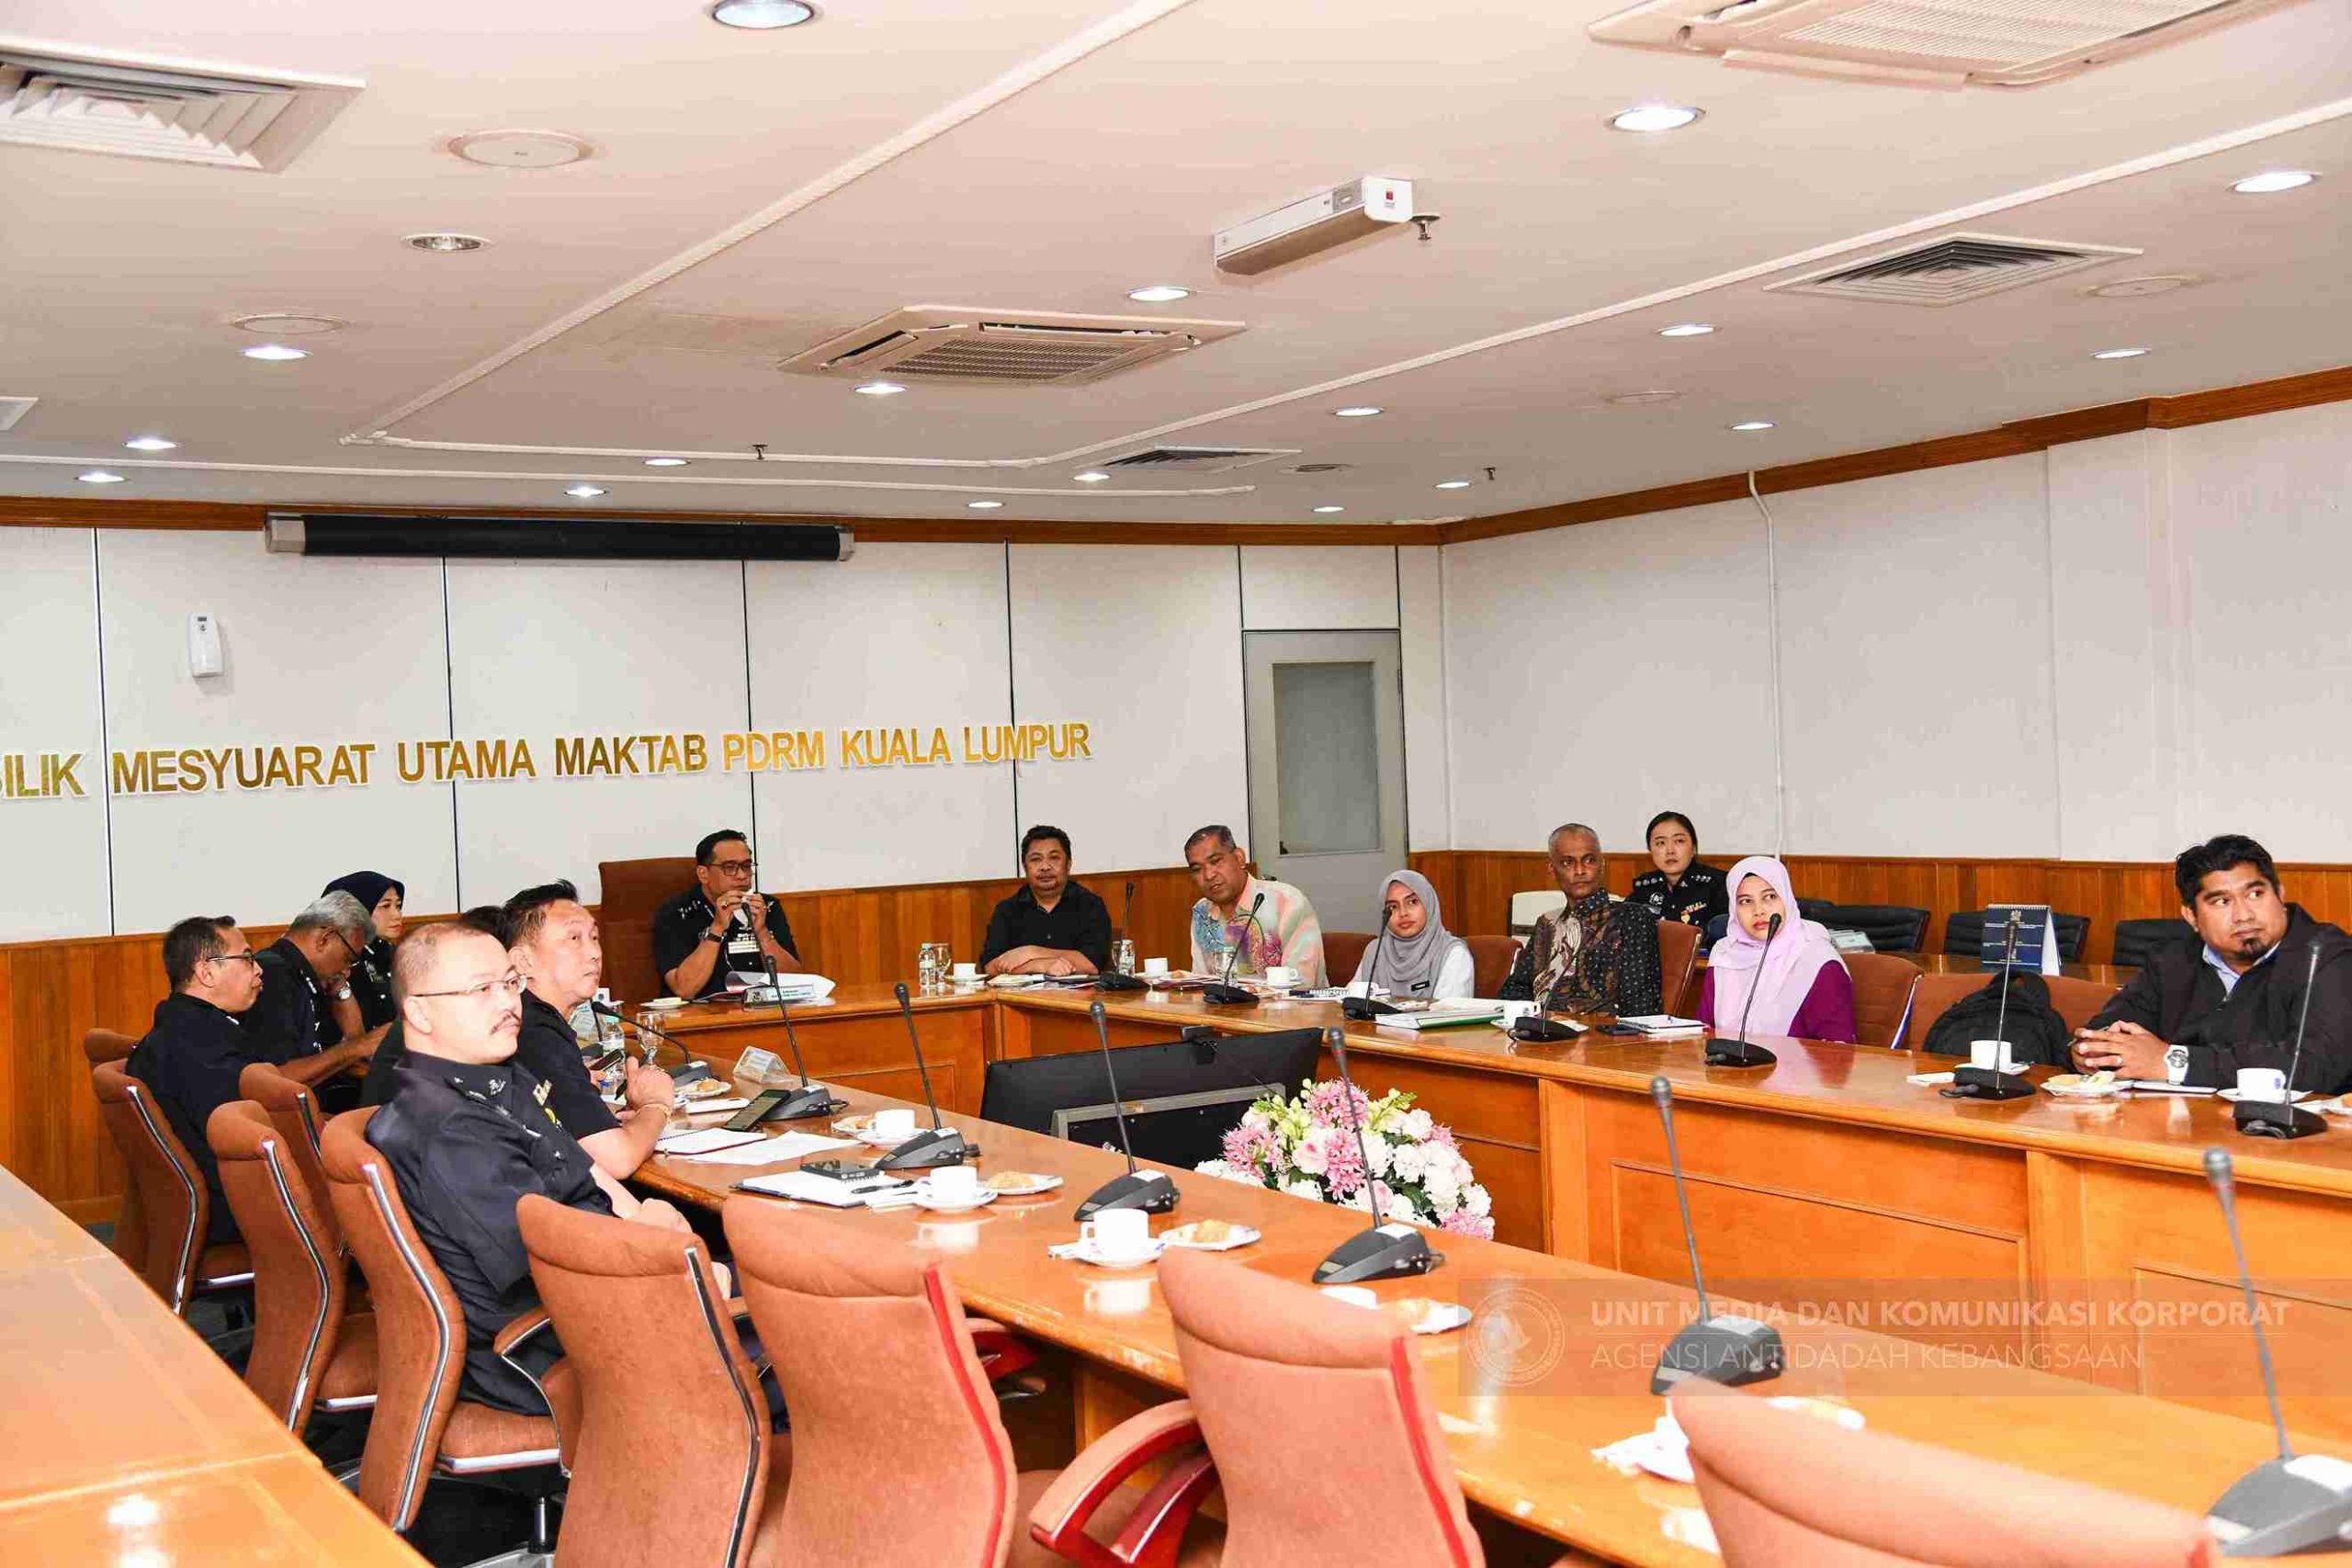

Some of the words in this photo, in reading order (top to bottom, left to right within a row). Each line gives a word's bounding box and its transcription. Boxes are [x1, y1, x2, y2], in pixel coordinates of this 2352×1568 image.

[0, 752, 86, 797] ILIK
[111, 742, 377, 794] MESYUARAT
[397, 739, 537, 783] UTAMA
[554, 734, 708, 776] MAKTAB
[722, 730, 825, 771] PDRM
[841, 728, 951, 768] KUALA
[963, 722, 1092, 762] LUMPUR
